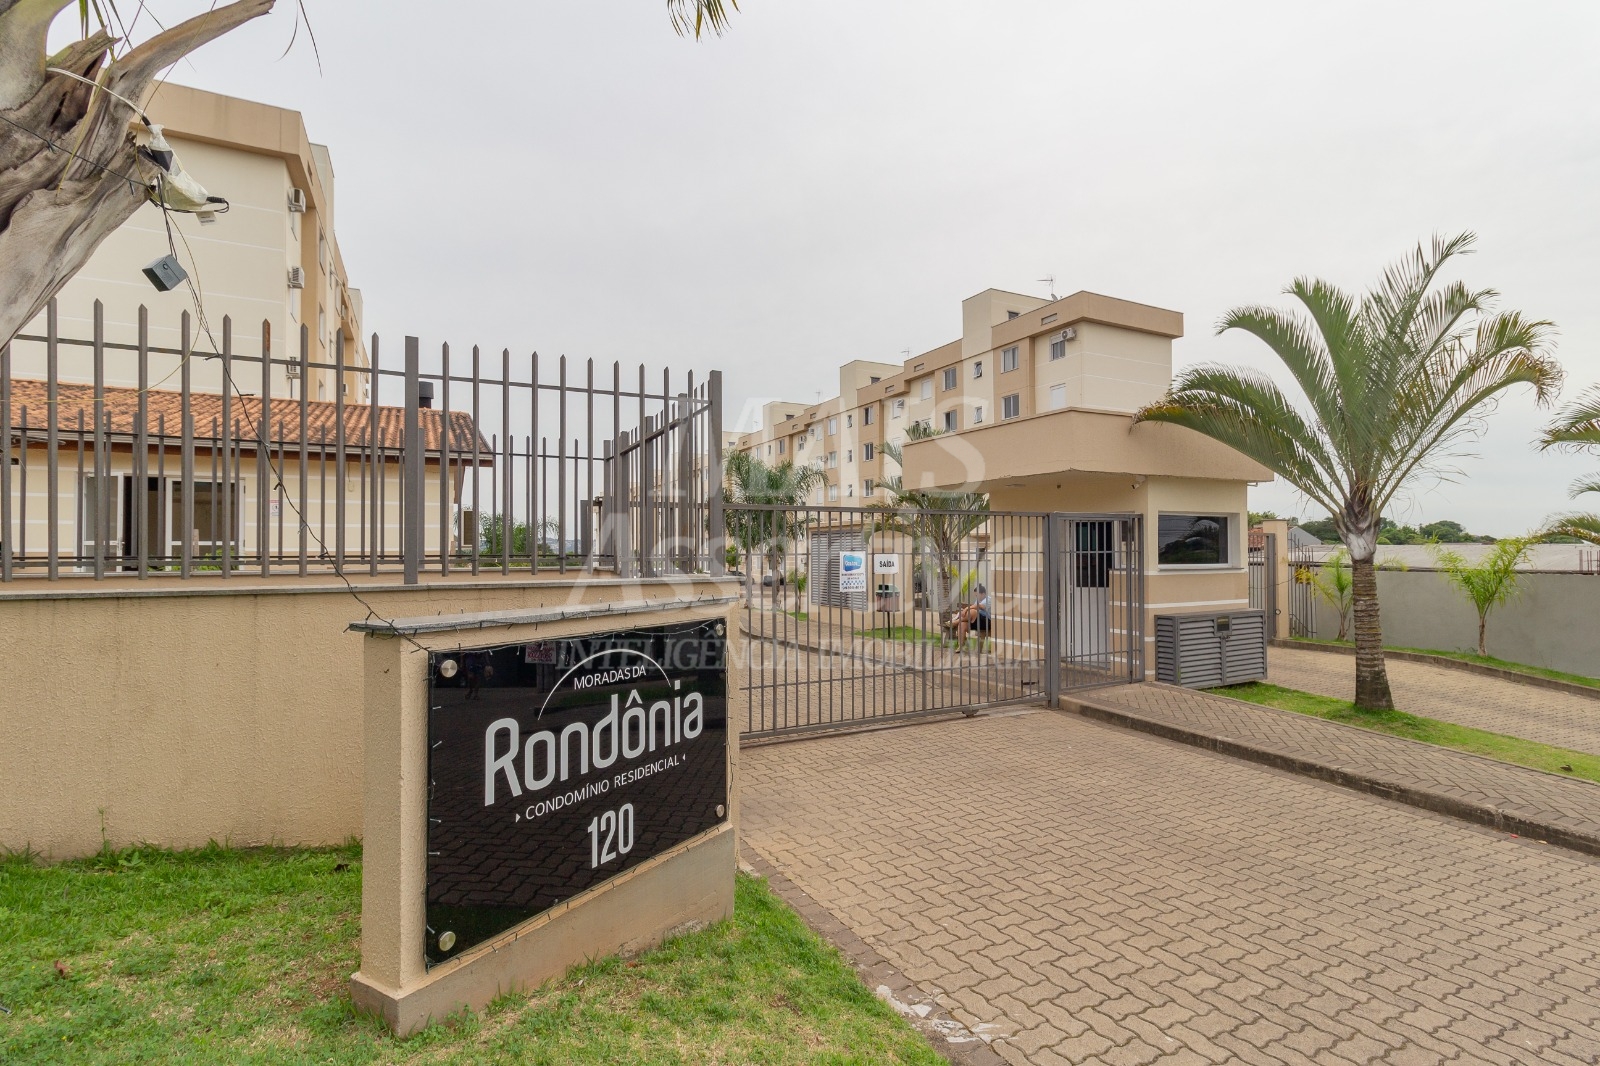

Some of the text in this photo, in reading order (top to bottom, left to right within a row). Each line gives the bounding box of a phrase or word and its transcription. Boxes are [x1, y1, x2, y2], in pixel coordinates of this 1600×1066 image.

[879, 559, 895, 568] SAÍDA
[573, 664, 647, 690] MORADAS DA
[484, 680, 704, 807] Rondônia
[525, 754, 680, 820] CONDOMÍNIO RESIDENCIAL
[587, 803, 634, 869] 120
